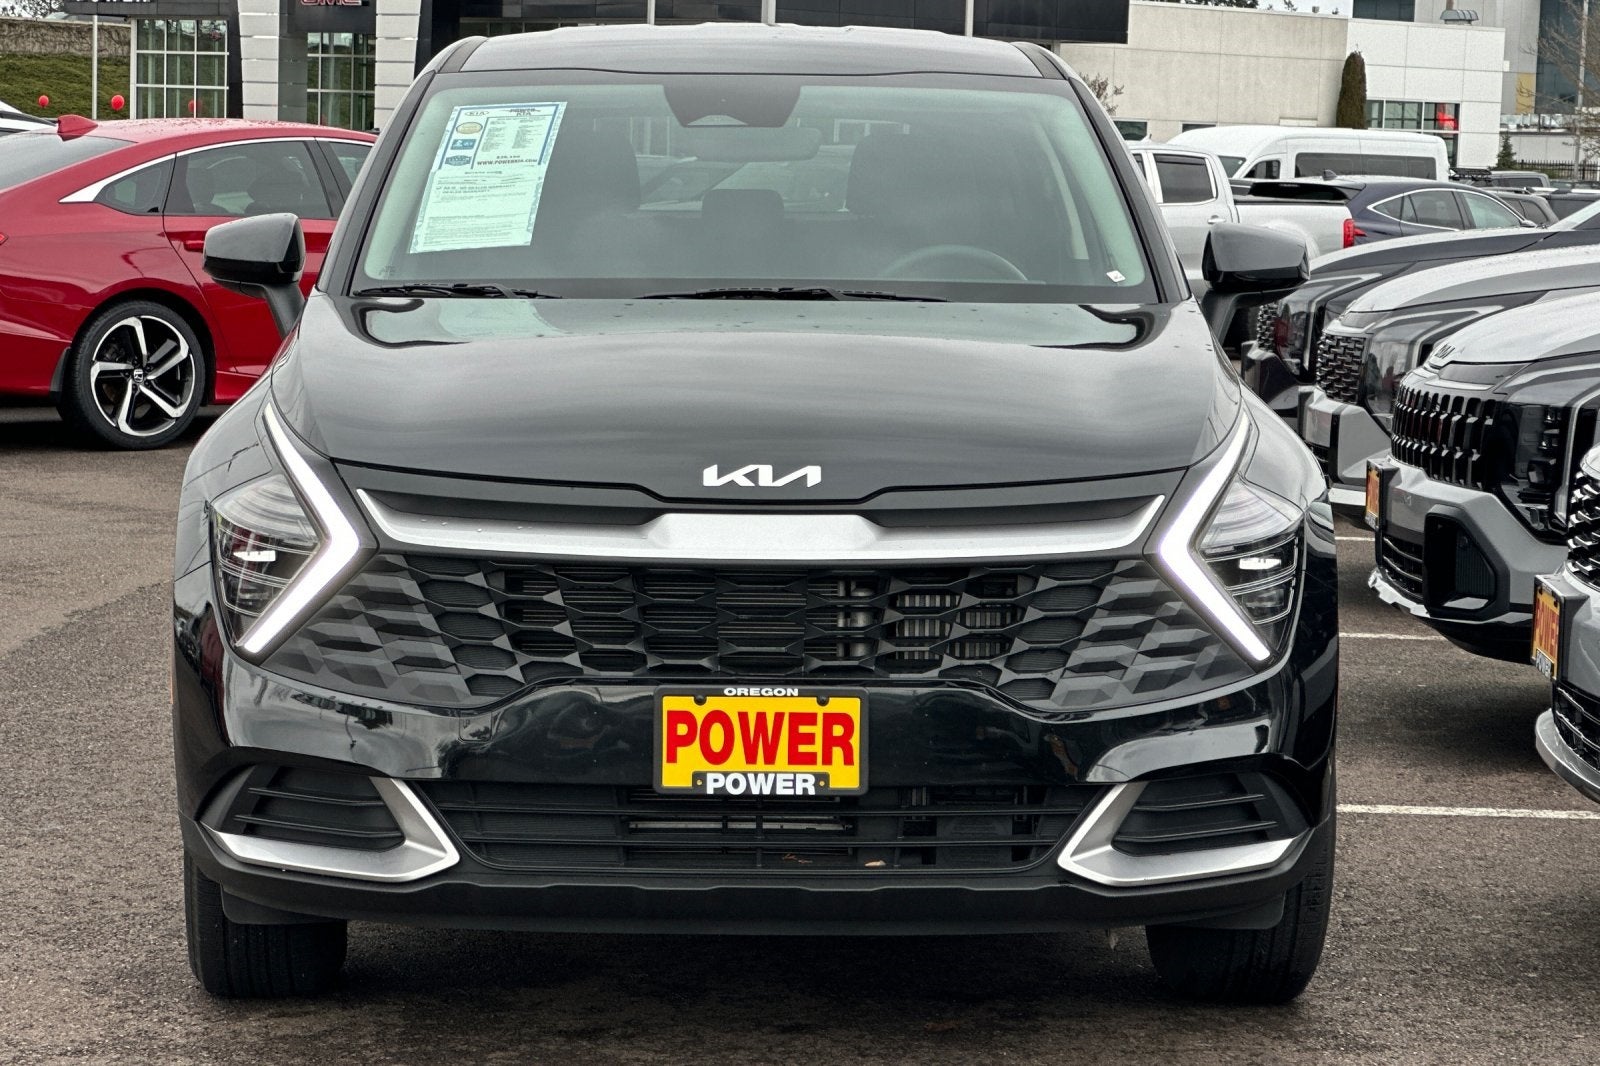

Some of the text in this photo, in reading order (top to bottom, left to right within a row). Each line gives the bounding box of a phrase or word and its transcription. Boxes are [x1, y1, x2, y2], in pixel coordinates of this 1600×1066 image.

[703, 464, 822, 488] KIA
[723, 687, 799, 697] OREGON
[666, 709, 855, 766] POWER
[706, 772, 816, 796] POWER
